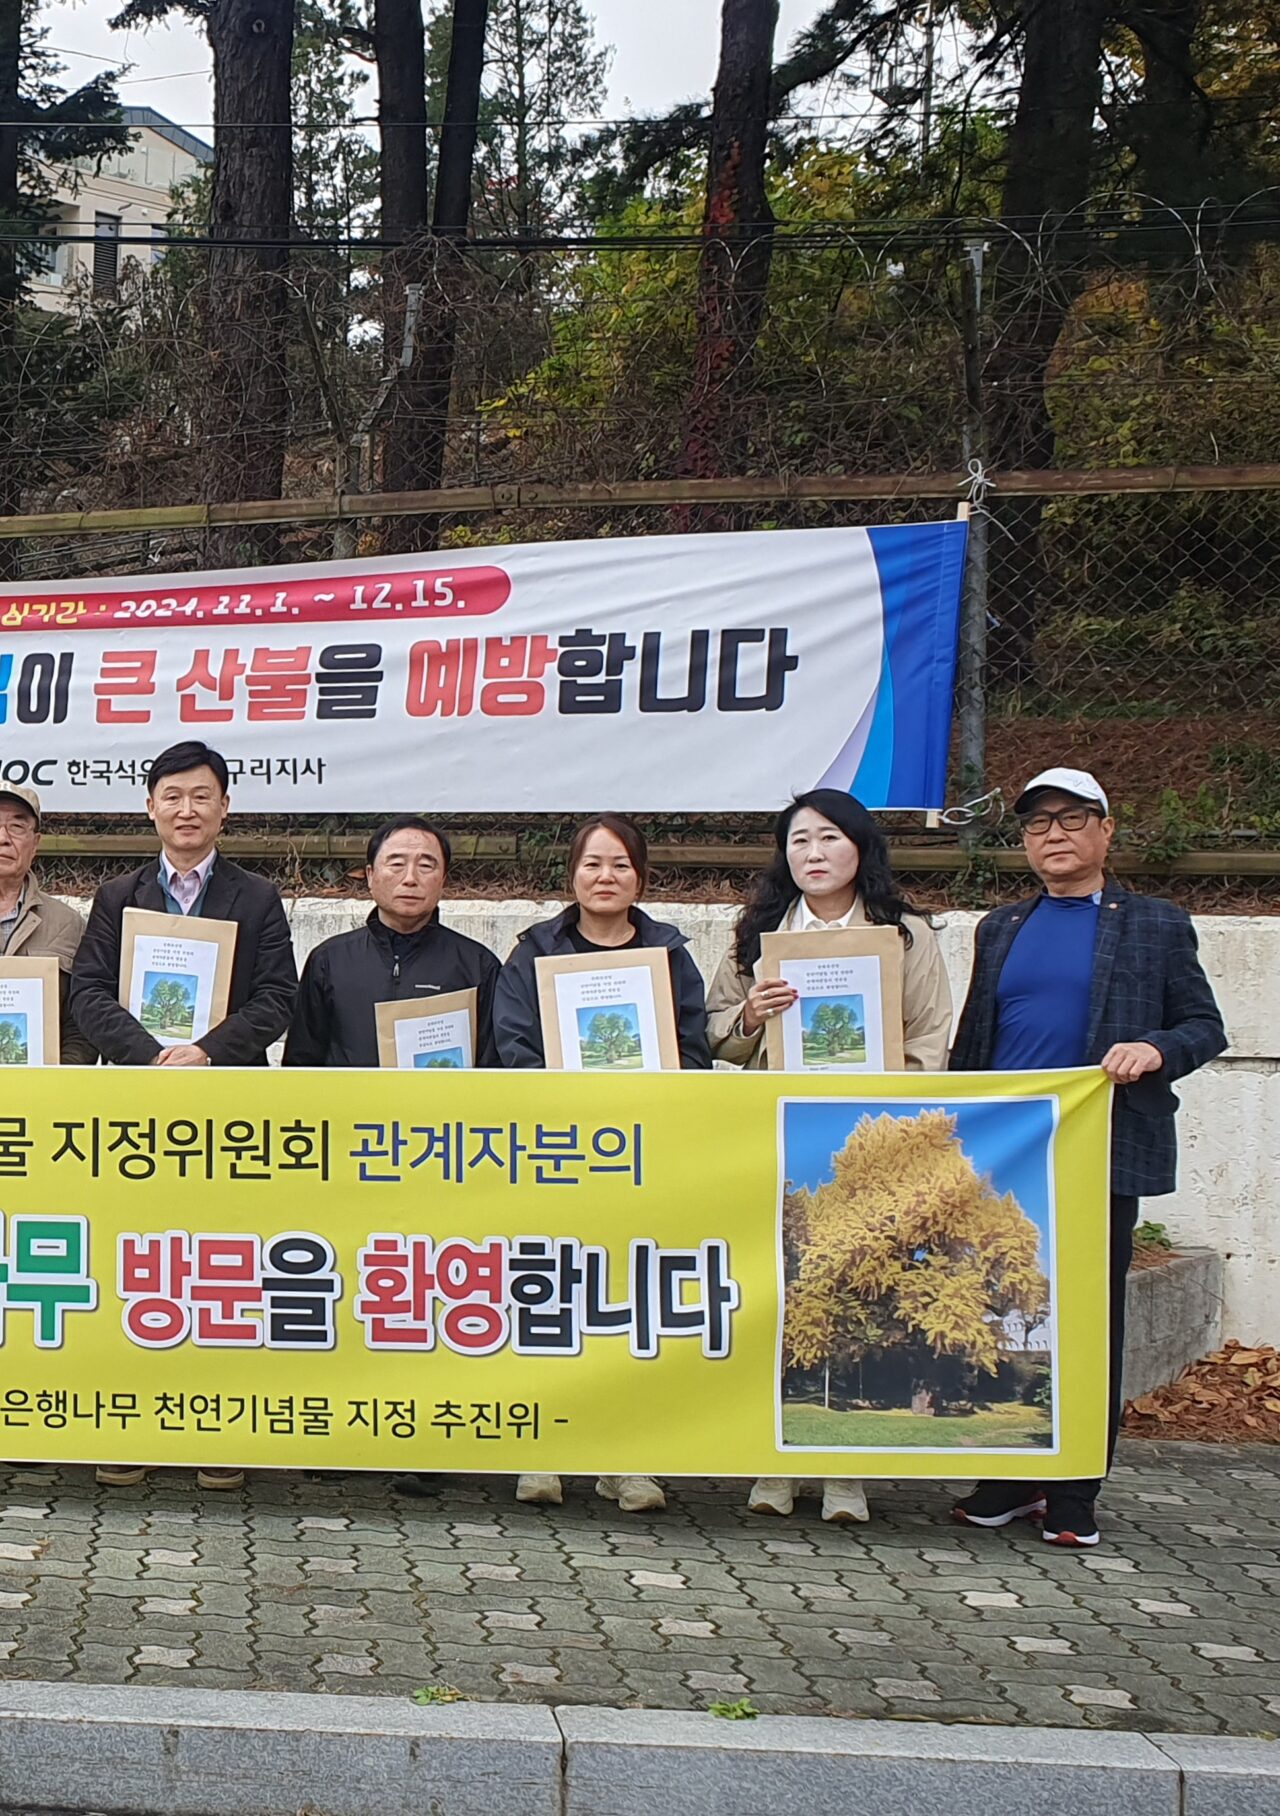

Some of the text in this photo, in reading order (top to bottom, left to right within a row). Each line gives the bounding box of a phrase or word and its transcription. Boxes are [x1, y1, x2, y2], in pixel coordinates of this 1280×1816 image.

[349, 576, 466, 611] 12.15.
[92, 648, 156, 724] 큰
[174, 642, 385, 724] 산불을
[404, 626, 800, 718] 예방합니다
[224, 757, 327, 785] 구리지사
[49, 1116, 331, 1181] 지정위원회
[348, 1120, 643, 1187] 관계자분의
[119, 1232, 336, 1349] 방문을
[357, 1234, 736, 1355] 환영합니다
[0, 1389, 142, 1430] 은행나무
[153, 1393, 335, 1437] 천연기념물
[346, 1397, 418, 1439] 지정
[429, 1400, 541, 1440] 추진위
